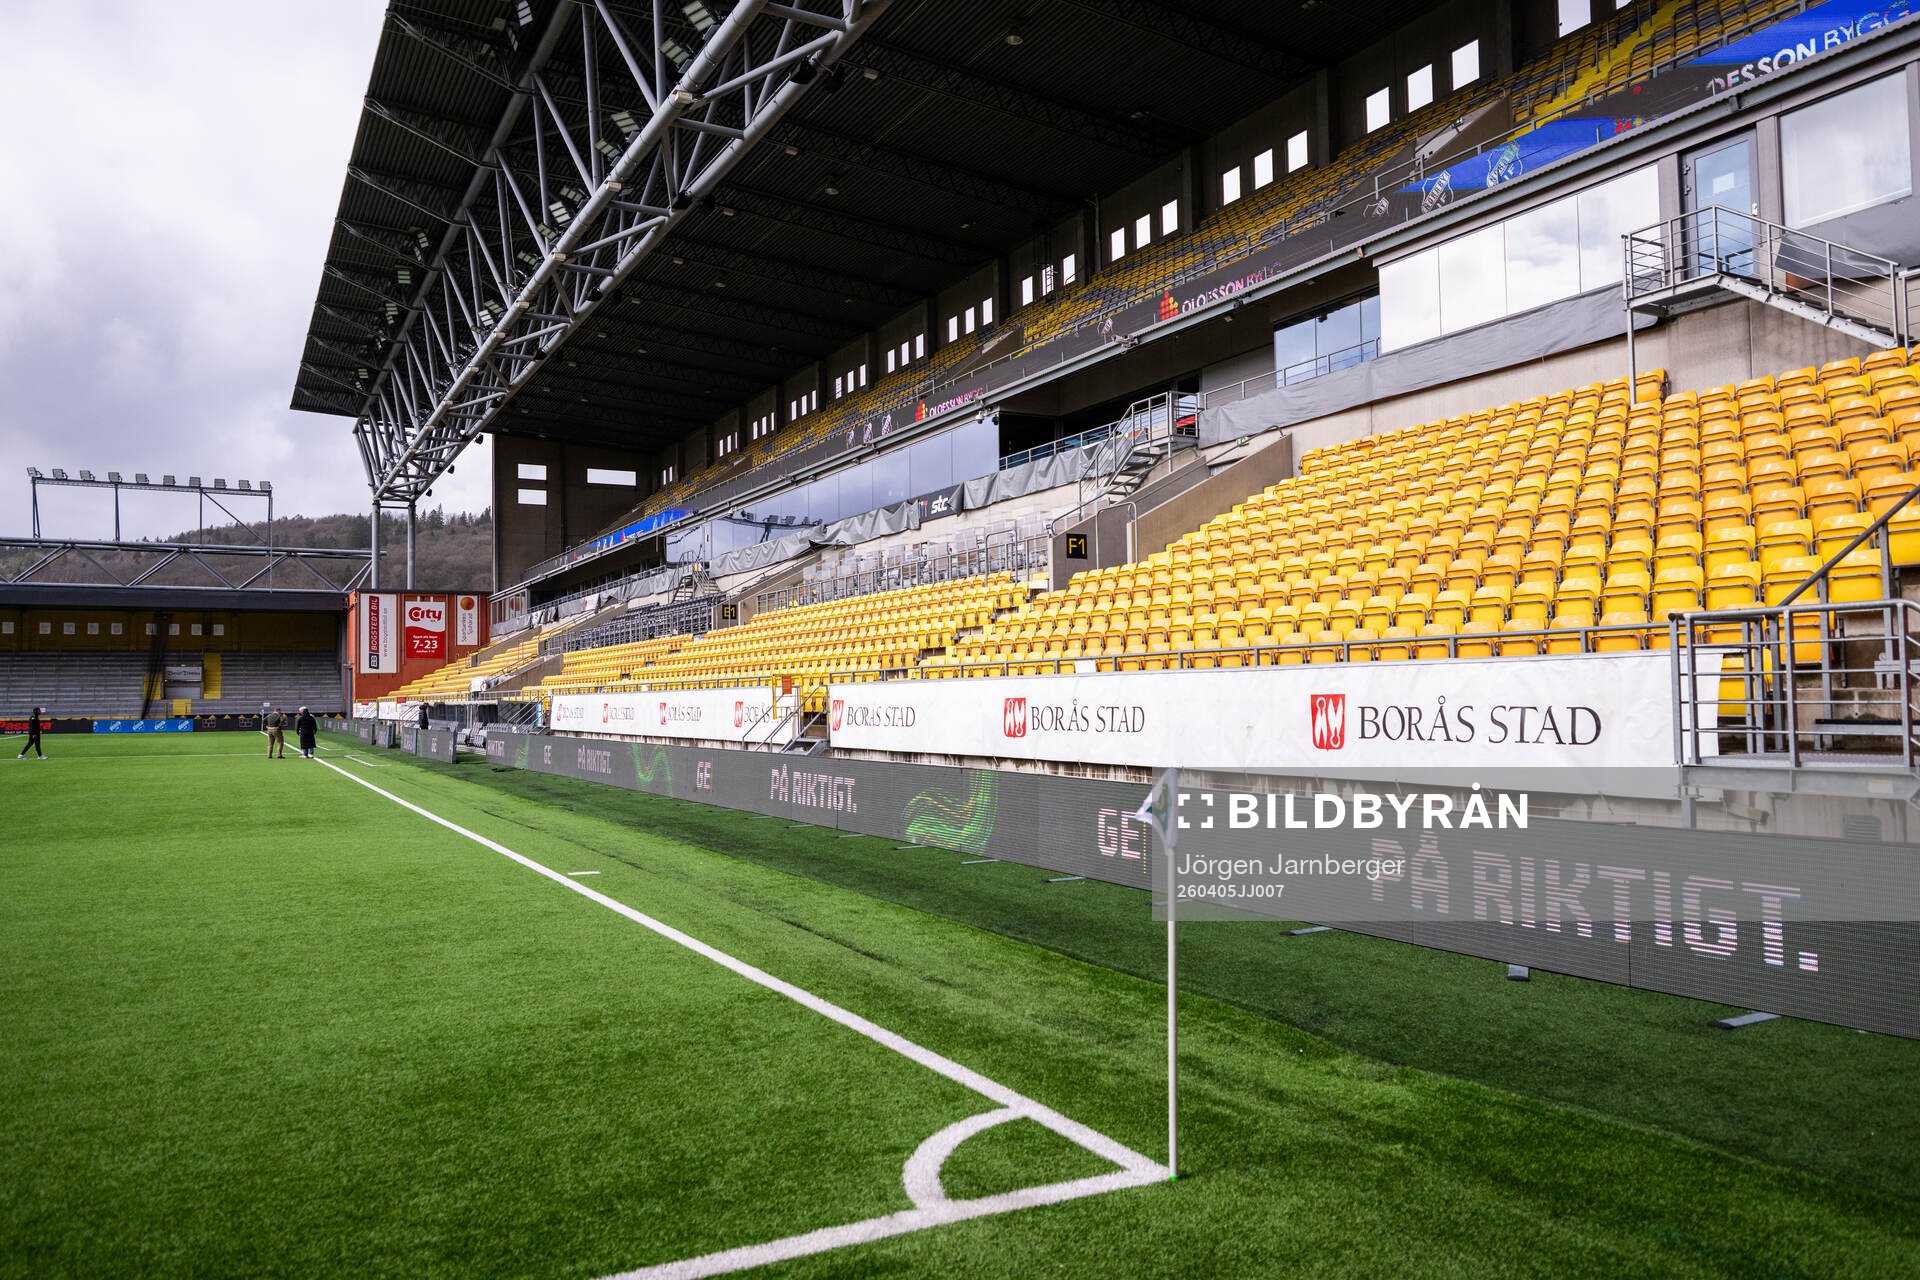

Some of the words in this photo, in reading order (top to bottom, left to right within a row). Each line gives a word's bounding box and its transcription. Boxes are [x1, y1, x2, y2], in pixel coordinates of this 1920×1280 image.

[931, 495, 949, 514] stc
[1068, 538, 1085, 555] F1
[408, 607, 442, 621] City
[724, 606, 735, 617] E1
[412, 640, 438, 649] 7-23
[847, 701, 881, 727] BORÅS
[884, 706, 916, 727] STAD
[1031, 699, 1089, 732] BORÅS
[1095, 705, 1145, 733] STAD
[1358, 695, 1475, 743] BORÅS
[1488, 705, 1601, 745] STAD
[696, 761, 712, 789] GE
[770, 764, 789, 802] PÅ
[792, 771, 857, 813] RIKTIGT.
[1097, 808, 1141, 860] GE
[1371, 831, 1450, 914] PÅ
[1472, 849, 1819, 972] RIKTIGT.
